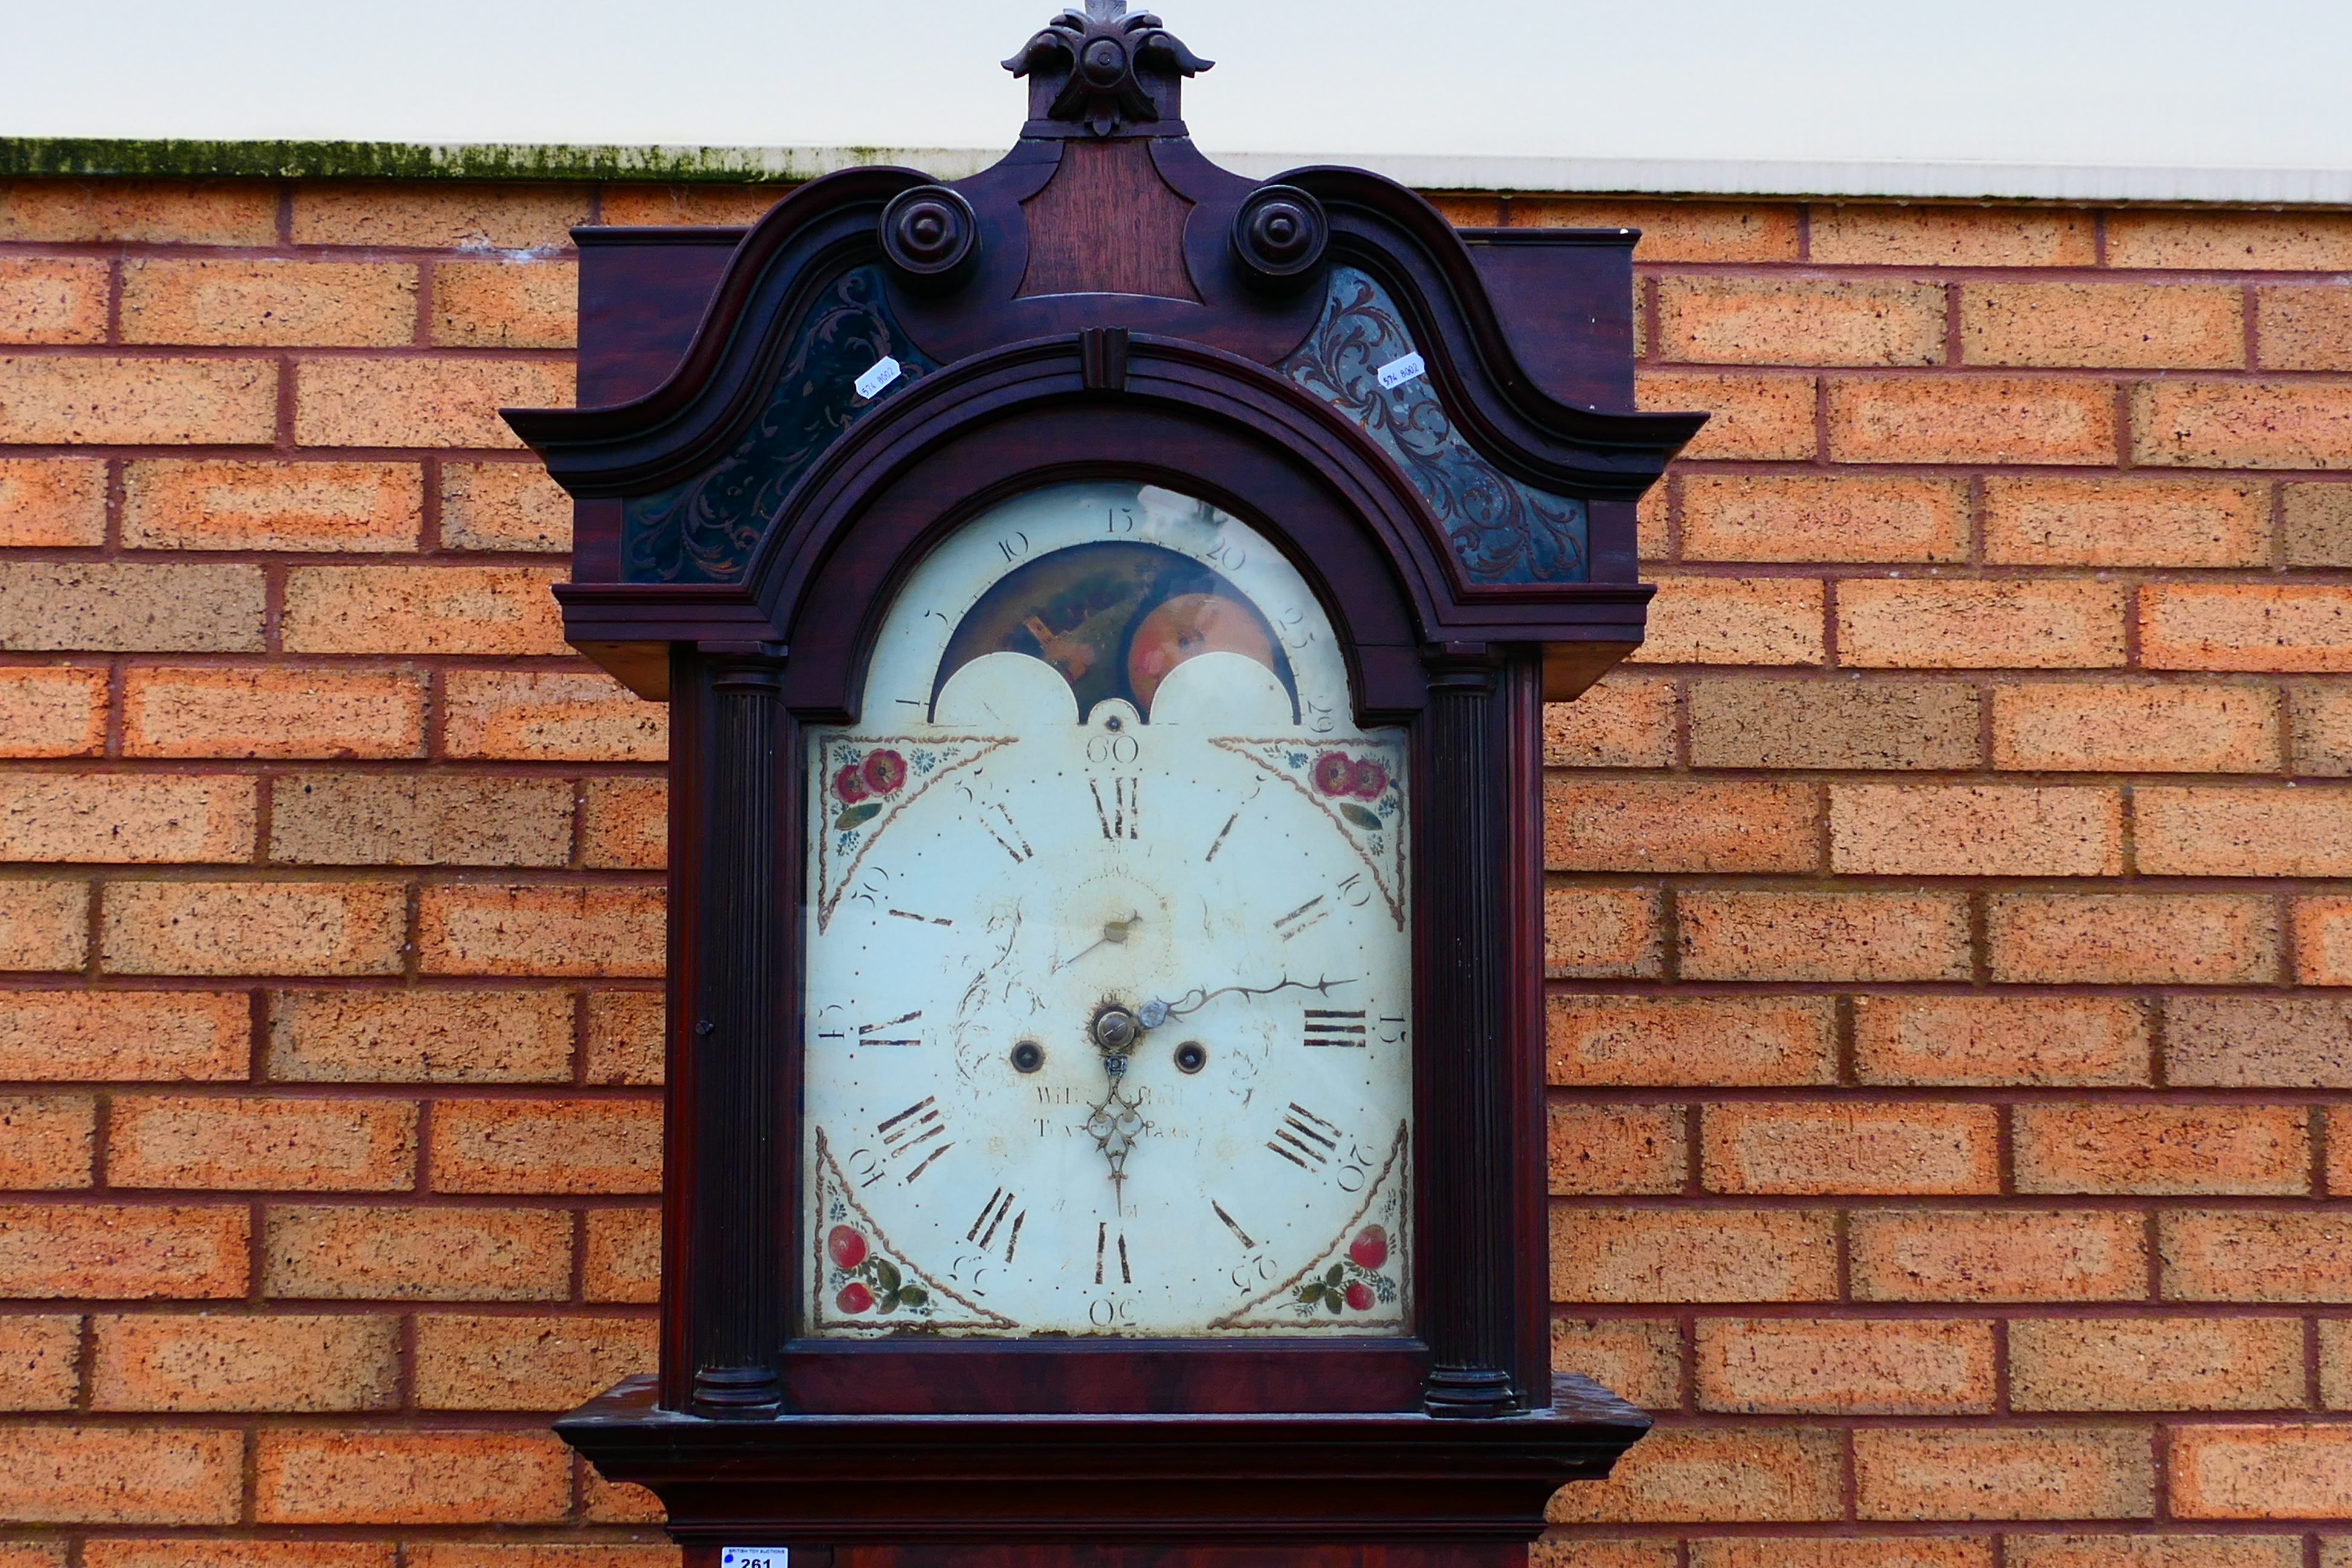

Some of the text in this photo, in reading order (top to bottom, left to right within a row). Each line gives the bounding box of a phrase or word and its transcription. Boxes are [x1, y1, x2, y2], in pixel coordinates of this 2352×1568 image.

[1400, 363, 1419, 377] 8002
[1107, 508, 1133, 532] 15
[999, 532, 1028, 562] 10
[1206, 536, 1246, 570] 20
[1087, 735, 1139, 764] 60
[1336, 872, 1371, 906] 10
[1304, 1010, 1366, 1048] III
[1380, 1011, 1406, 1044] 15
[1337, 1143, 1374, 1192] 20
[741, 1559, 771, 1568] 261
